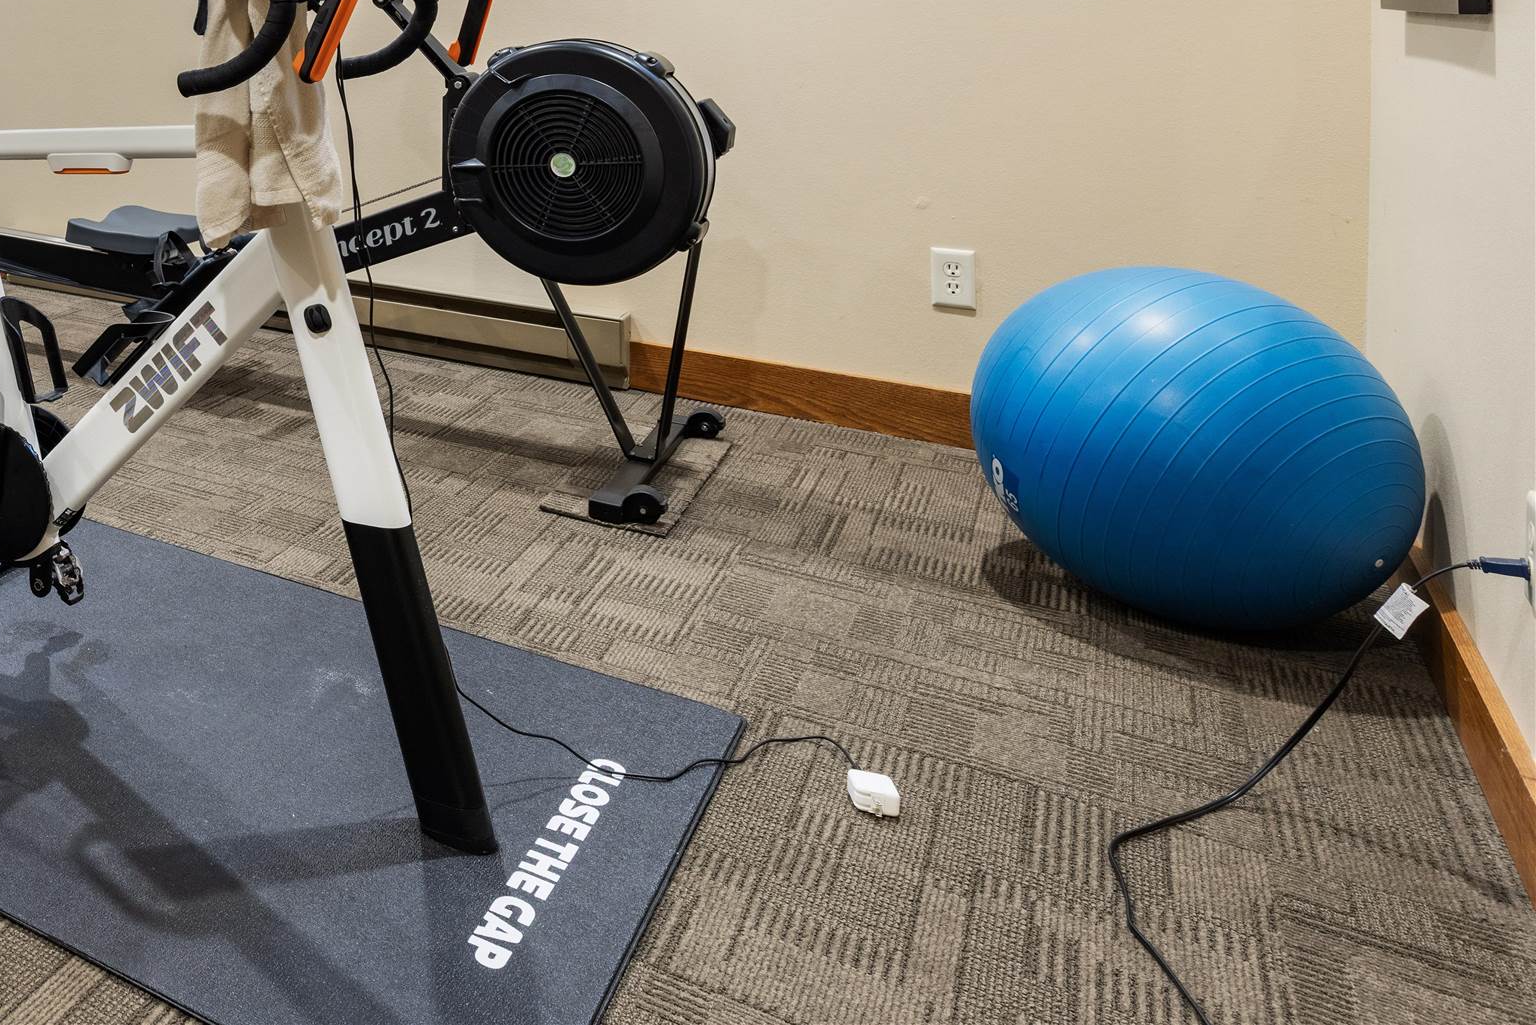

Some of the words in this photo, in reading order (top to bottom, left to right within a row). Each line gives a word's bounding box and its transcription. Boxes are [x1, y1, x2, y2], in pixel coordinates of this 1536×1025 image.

[338, 216, 417, 257] ncept
[420, 207, 440, 229] 2
[109, 300, 228, 434] ZWIFT
[545, 758, 627, 842] CLOSE
[505, 837, 580, 901] THE
[467, 895, 536, 970] GAP
